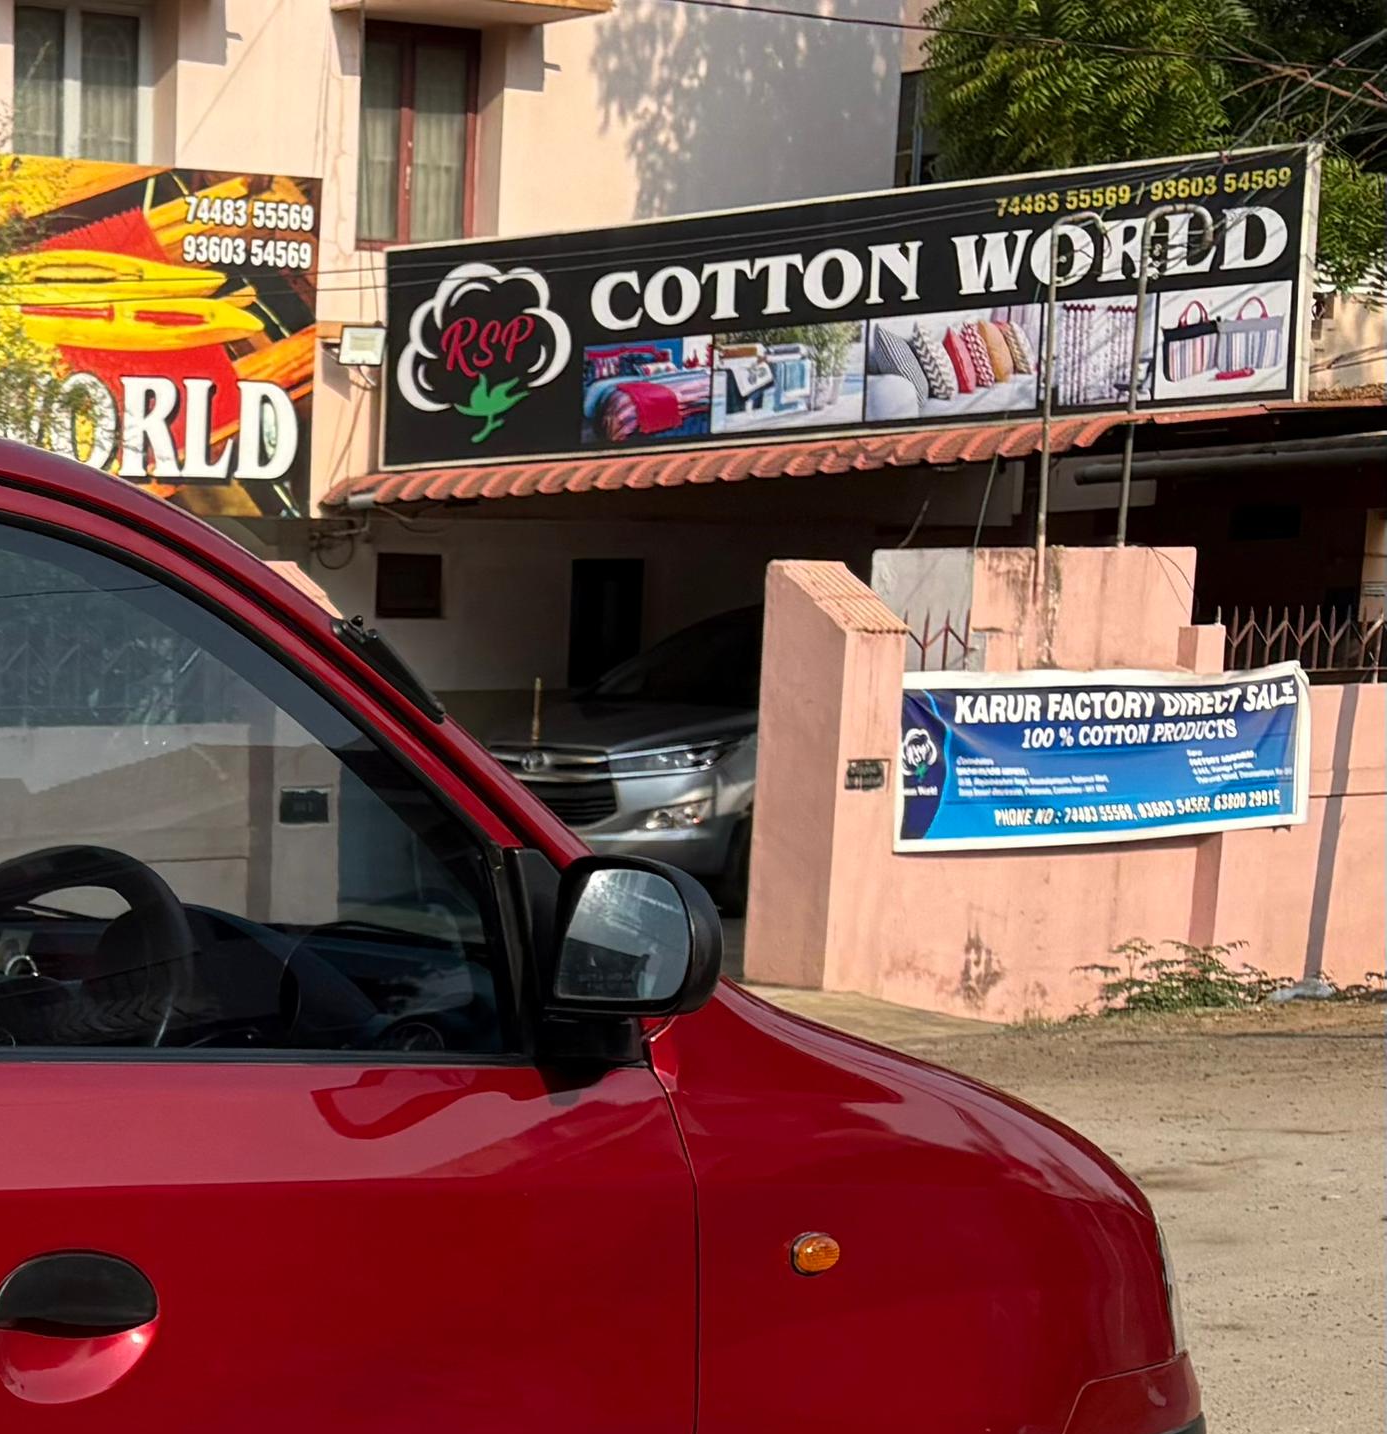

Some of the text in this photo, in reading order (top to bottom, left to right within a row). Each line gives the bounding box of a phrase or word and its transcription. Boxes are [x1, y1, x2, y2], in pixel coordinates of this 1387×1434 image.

[995, 192, 1059, 218] 74483
[1065, 184, 1131, 210] 55569
[1149, 174, 1218, 202] 93603
[1222, 166, 1293, 193] 54569
[184, 195, 315, 232] 74483 55569
[182, 234, 313, 270] 93603 54569
[590, 205, 1289, 332] COTTON WORLD
[441, 316, 537, 379] RSP
[954, 679, 1299, 724] KARUR FACTORY DIRECT SALE
[1021, 718, 1239, 749] 100 % COTTON PRODUCTS
[994, 807, 1033, 827] PHONE
